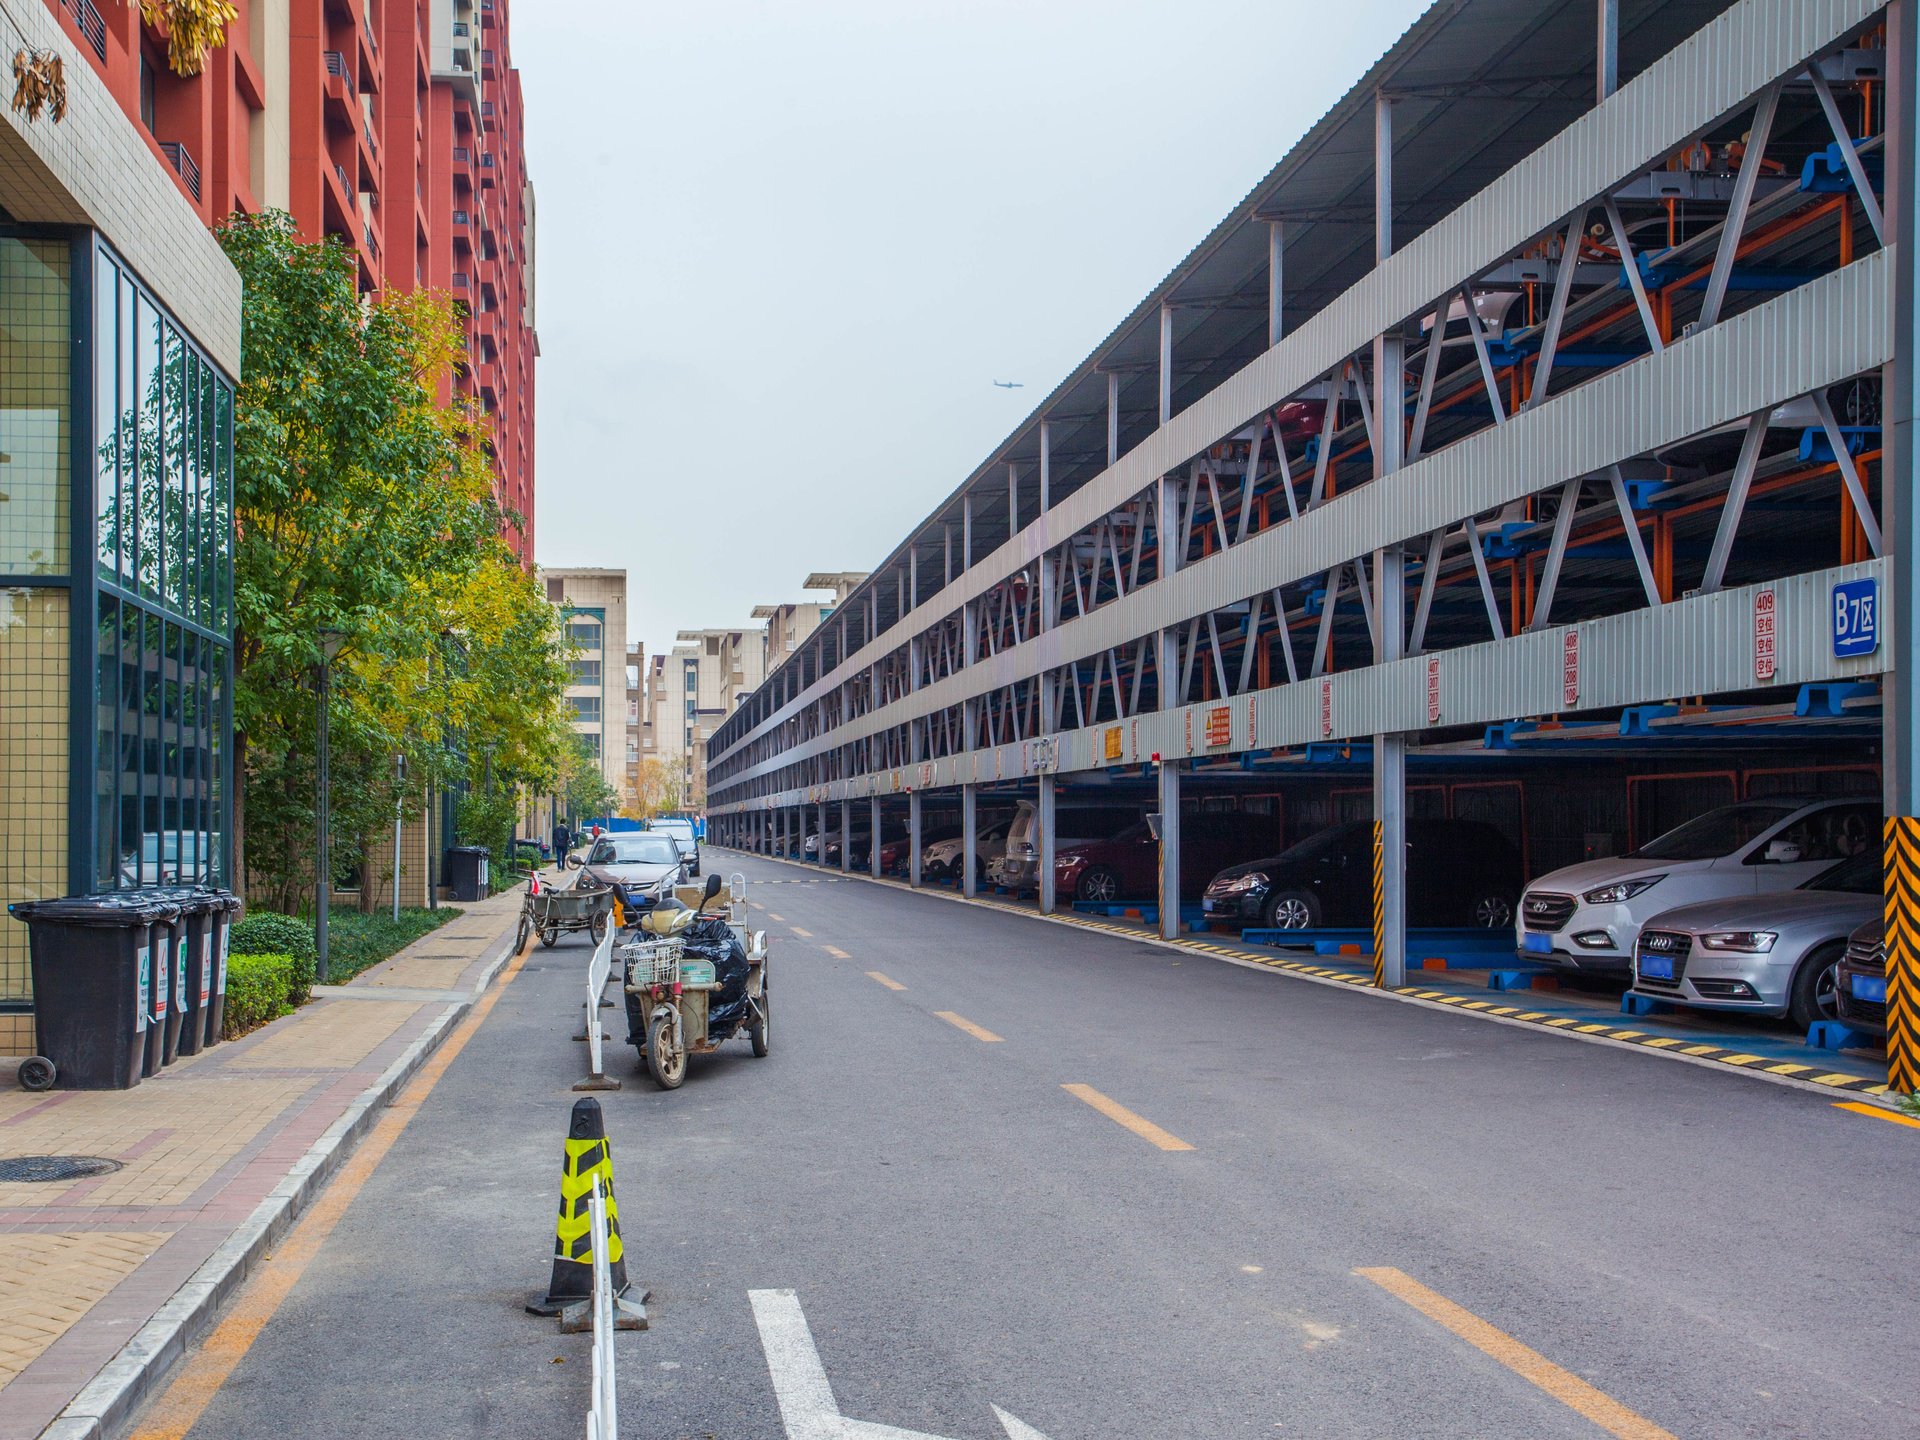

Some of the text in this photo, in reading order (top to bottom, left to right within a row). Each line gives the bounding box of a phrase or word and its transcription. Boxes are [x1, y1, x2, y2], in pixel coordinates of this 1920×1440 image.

[1757, 594, 1773, 611] 409
[1835, 592, 1874, 636] B7区
[1757, 616, 1773, 633] 空位
[1565, 634, 1577, 648] 408
[1757, 637, 1773, 654] 空位
[1565, 652, 1577, 666] 308
[1429, 661, 1438, 674] 407
[1757, 658, 1773, 675] 空位
[1429, 676, 1438, 689] 307
[1565, 670, 1577, 684] 208
[1429, 691, 1438, 704] 207
[1565, 687, 1577, 702] 108
[1429, 707, 1438, 719] 107
